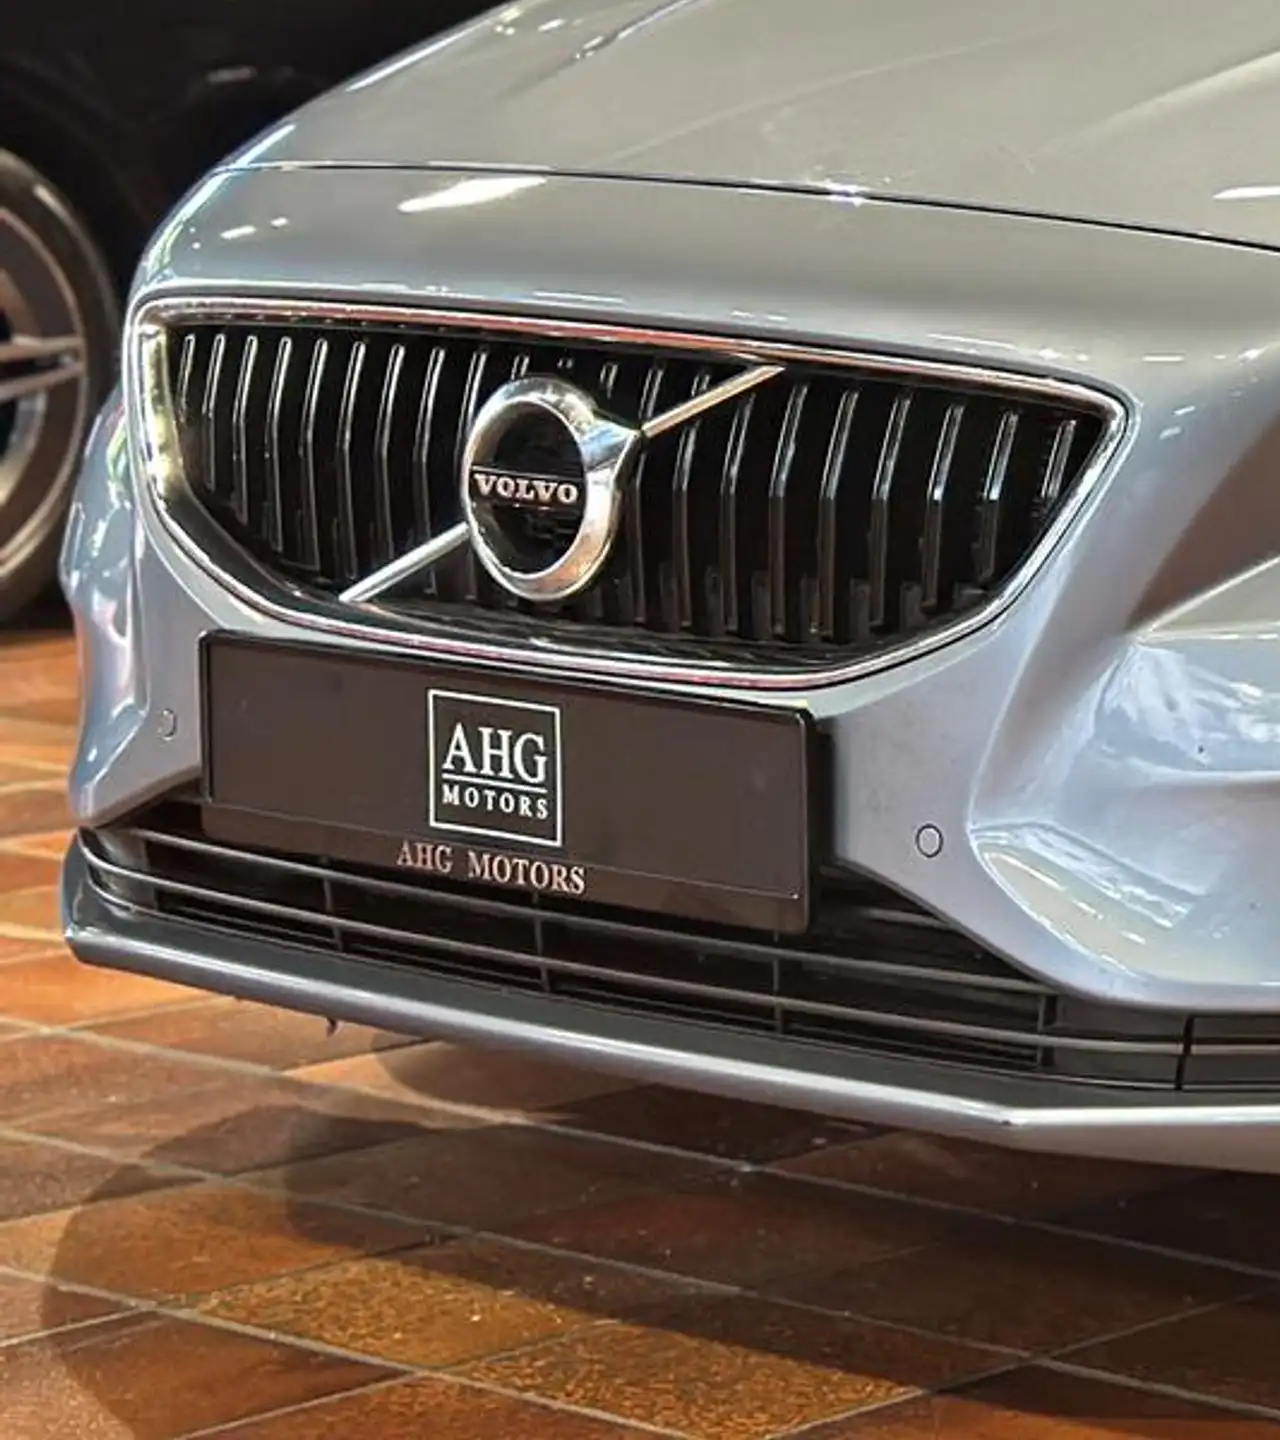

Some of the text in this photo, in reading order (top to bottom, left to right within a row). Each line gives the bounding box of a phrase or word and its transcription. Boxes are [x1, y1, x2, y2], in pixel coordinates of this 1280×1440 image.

[474, 473, 579, 503] VOLVO
[441, 722, 548, 783] AHG
[442, 784, 549, 819] MOTORS
[397, 840, 585, 894] AHG MOTORS
